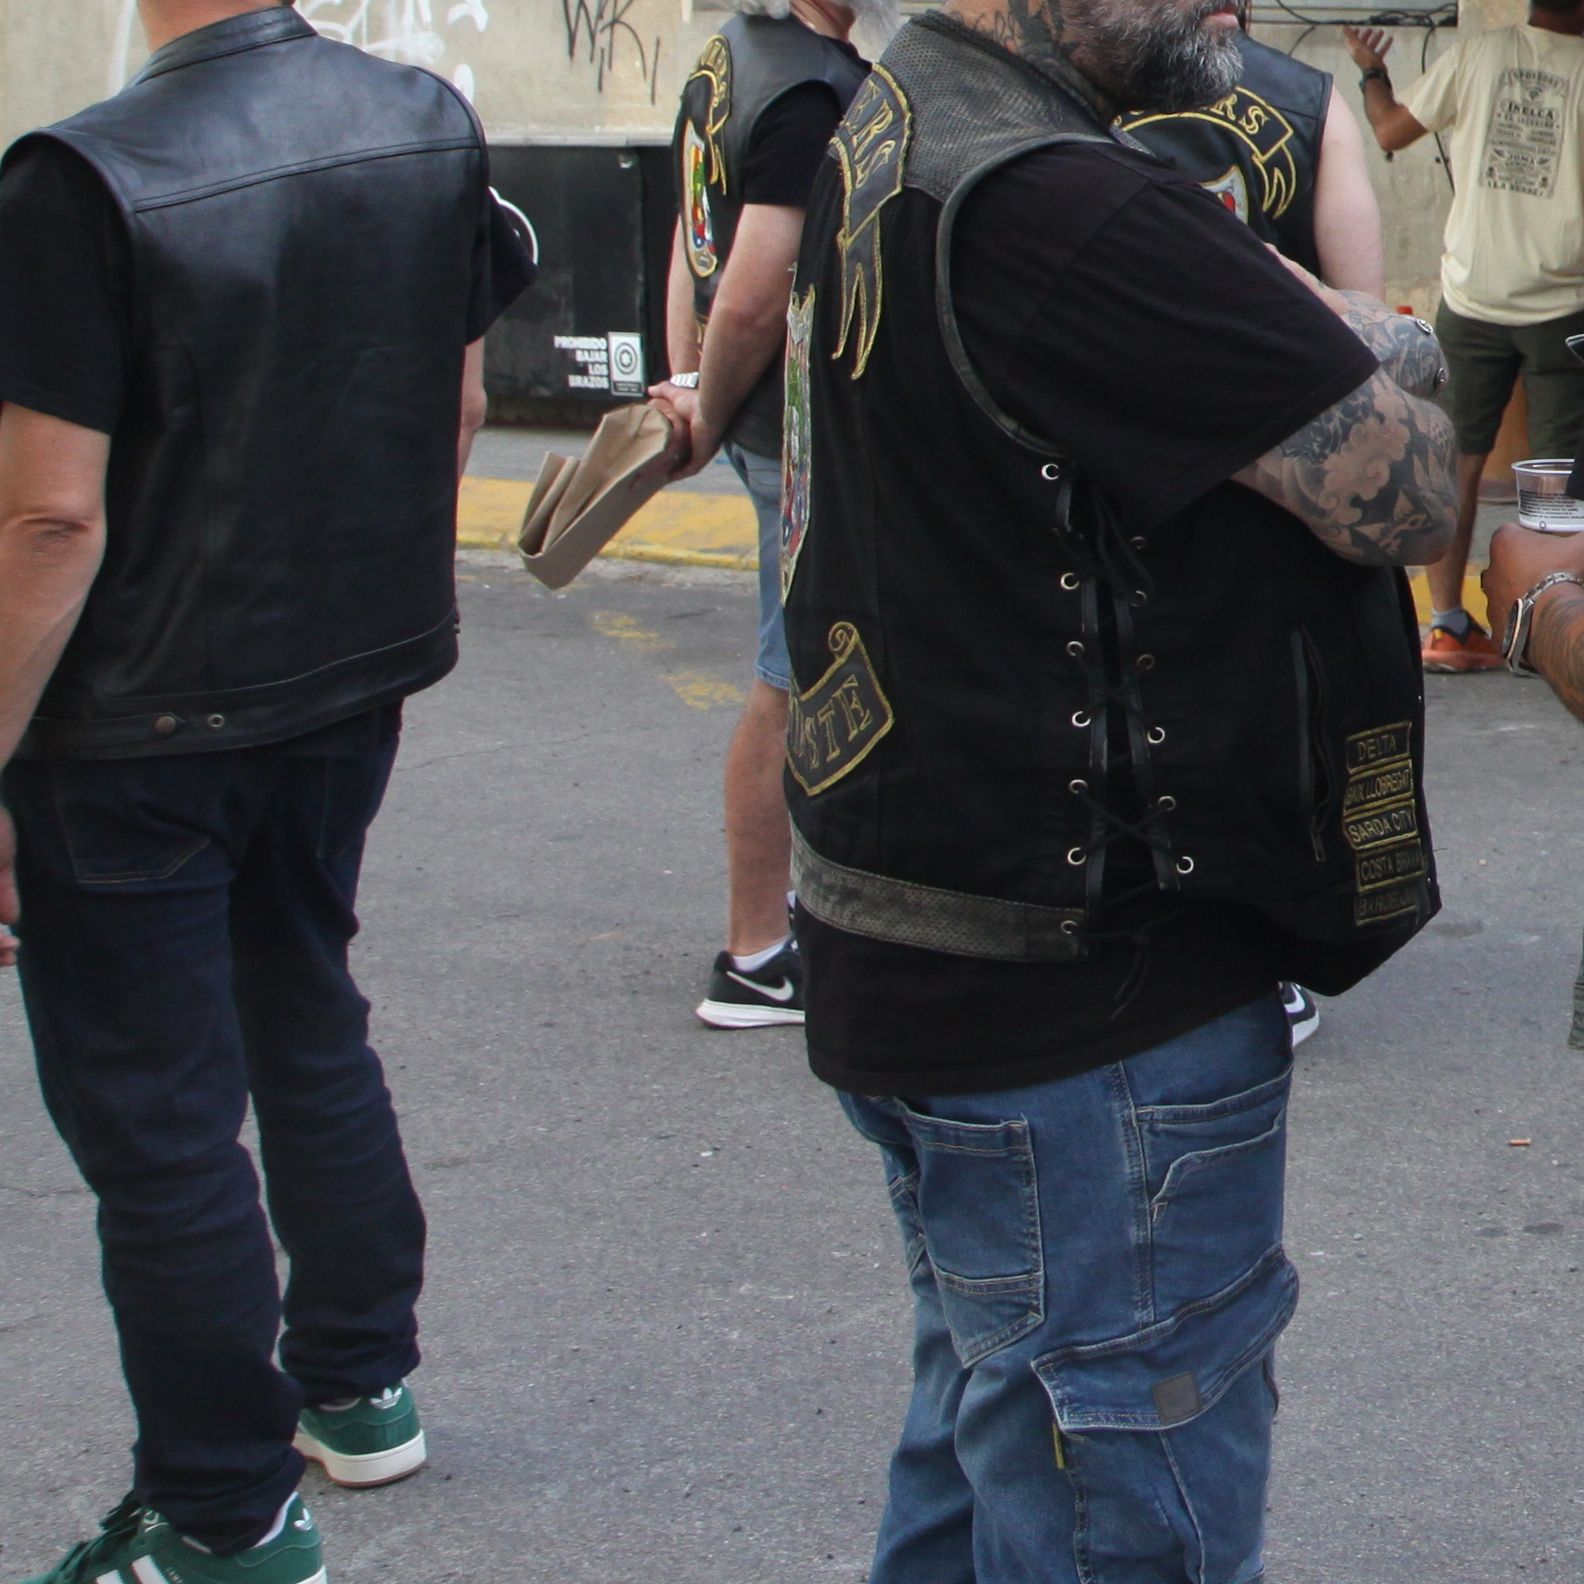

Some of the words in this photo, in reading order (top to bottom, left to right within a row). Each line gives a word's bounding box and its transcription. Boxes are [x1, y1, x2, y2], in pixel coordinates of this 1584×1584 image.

[553, 335, 608, 350] PROHIBIDO
[588, 362, 609, 376] LOS
[568, 374, 610, 389] BRAZOS
[1357, 734, 1397, 762] DELTA
[1349, 815, 1391, 844] SARDA
[1392, 809, 1414, 831] CITY
[1360, 856, 1393, 881] COSTA
